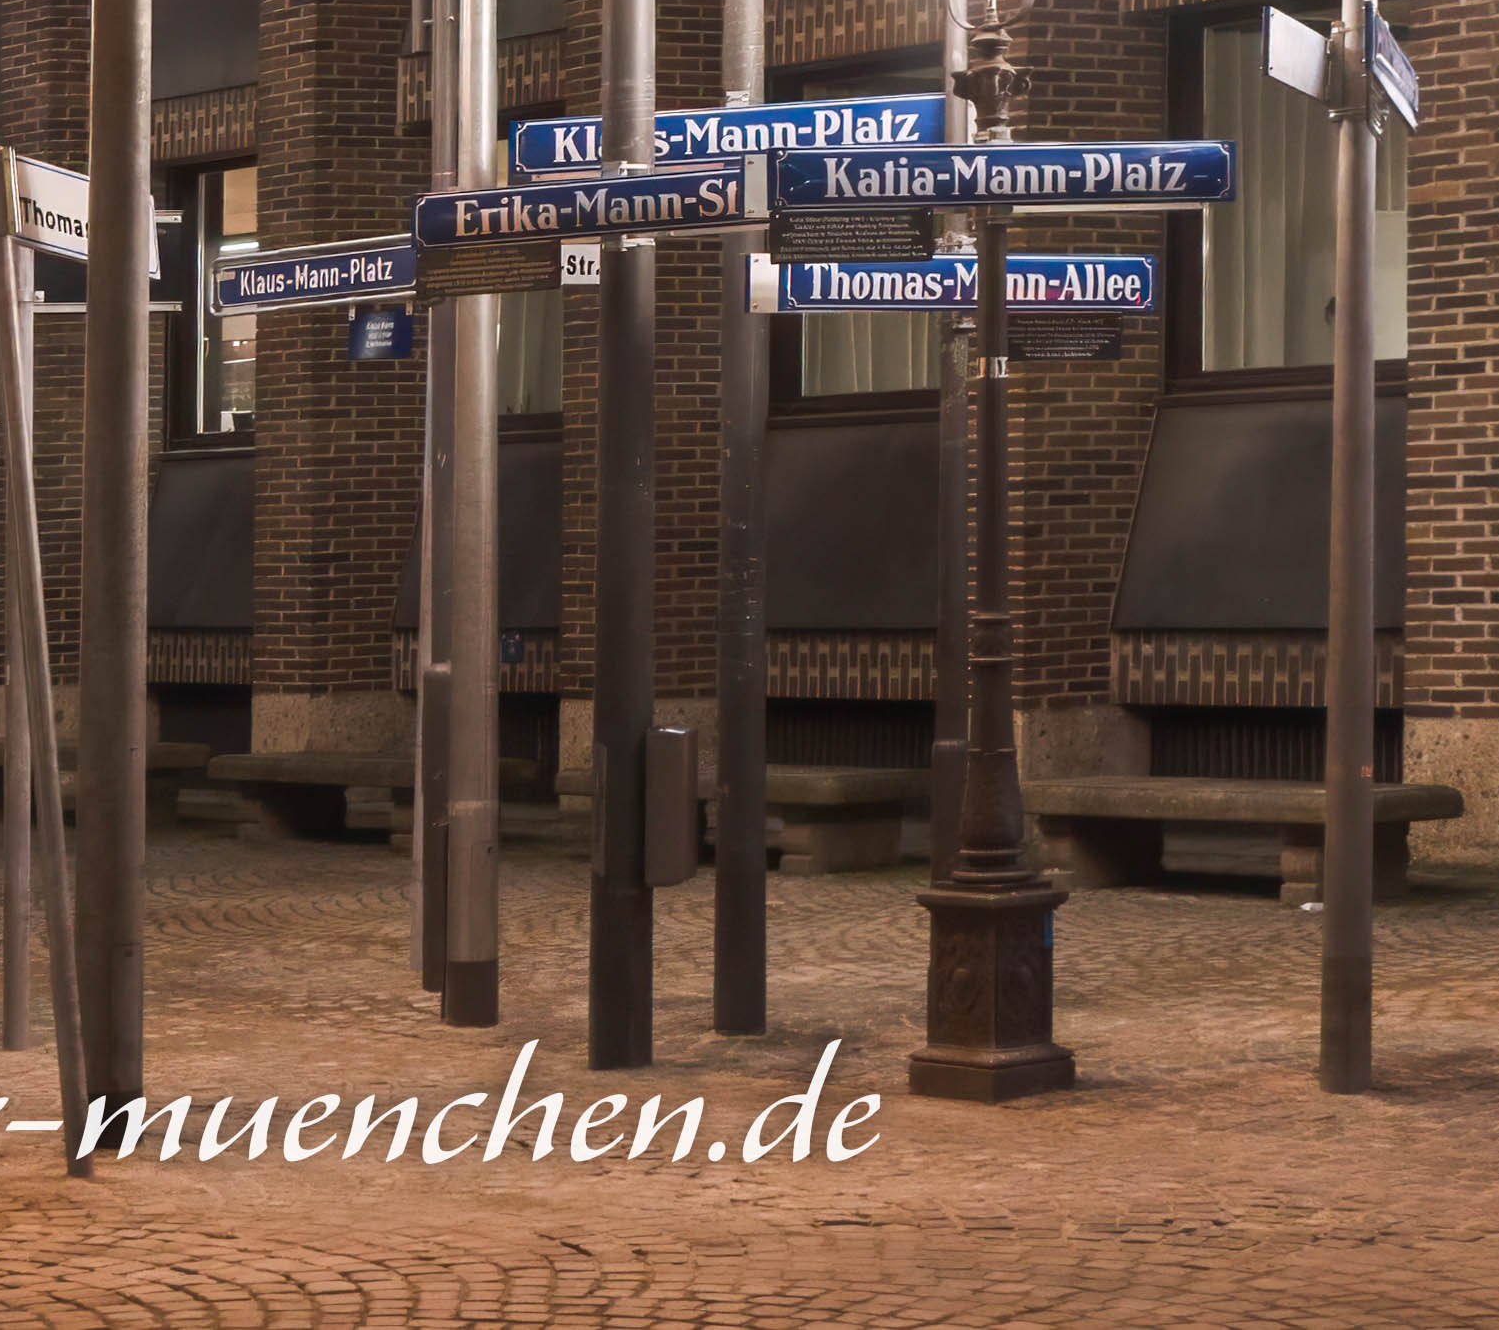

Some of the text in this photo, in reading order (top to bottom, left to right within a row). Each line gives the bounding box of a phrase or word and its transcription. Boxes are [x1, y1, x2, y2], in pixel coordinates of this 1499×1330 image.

[553, 108, 920, 163] Kls-Mann-Platz
[823, 152, 1187, 198] Katia-Mann-Platz
[19, 197, 89, 238] Thoma
[240, 256, 393, 297] Klaus-Mann-Platz
[804, 263, 1141, 302] Thomas-Mnn-Allee
